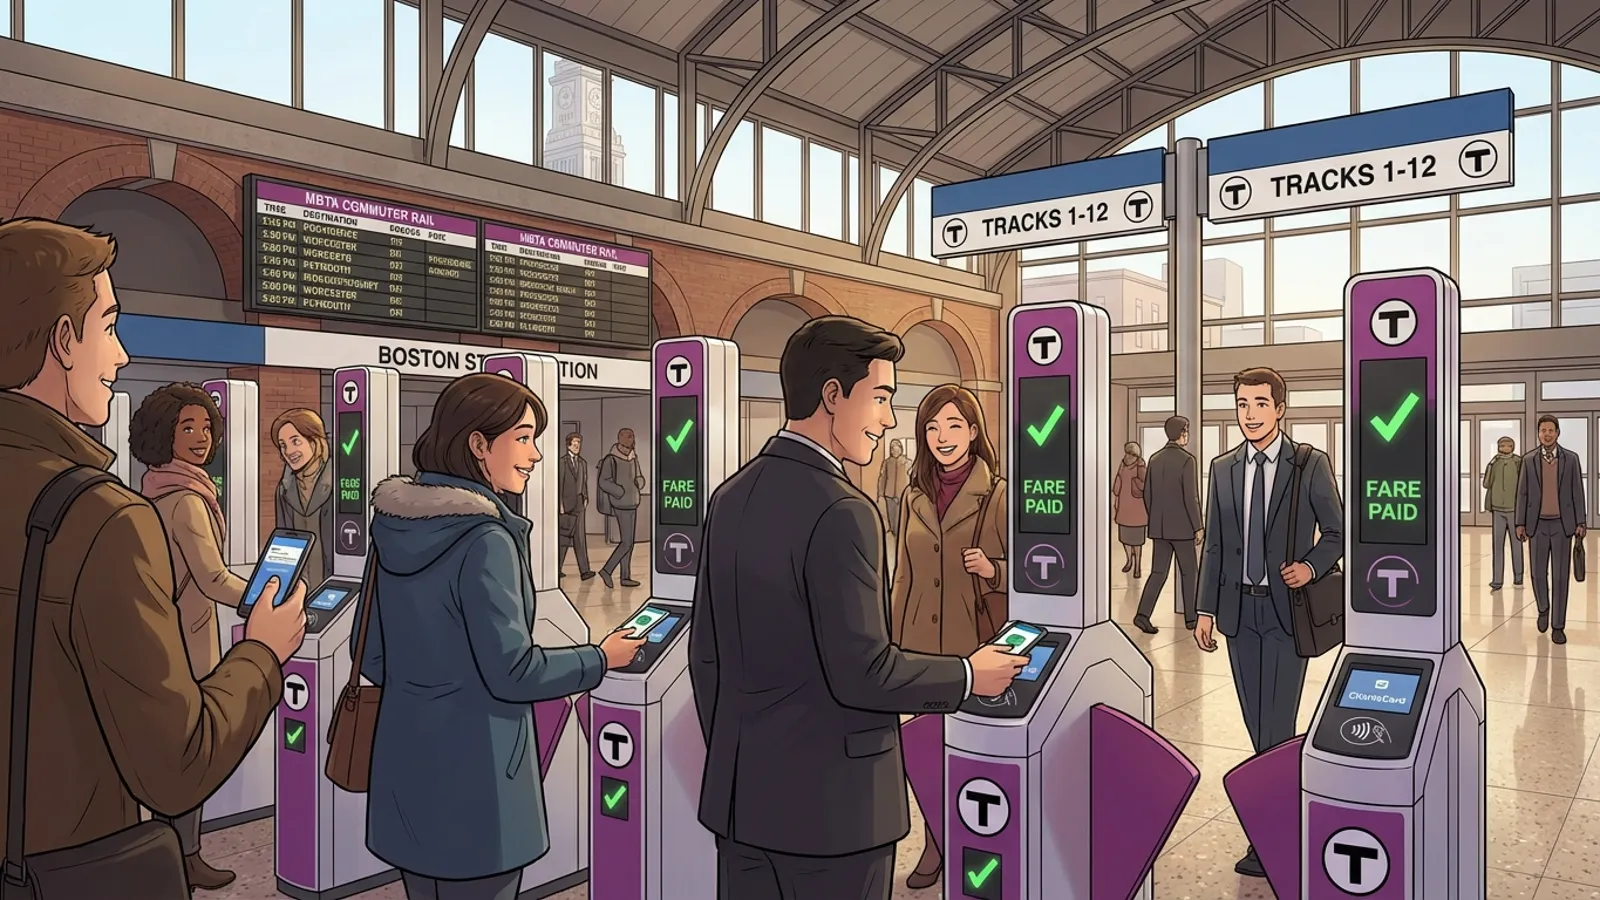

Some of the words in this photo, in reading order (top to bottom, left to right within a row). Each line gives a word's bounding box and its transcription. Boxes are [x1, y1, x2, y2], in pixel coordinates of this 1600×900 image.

[1224, 183, 1247, 205] T
[1270, 164, 1374, 197] TRACKS
[1383, 154, 1436, 182] 1-12
[1464, 149, 1491, 172] T
[946, 225, 963, 243] T
[982, 208, 1061, 237] TRACKS
[1068, 202, 1108, 226] 1-12
[1128, 198, 1148, 218] T
[1378, 310, 1410, 338] T
[379, 345, 459, 370] BOSTON
[1032, 335, 1057, 360] T
[670, 363, 688, 383] T
[344, 386, 356, 402] T
[662, 480, 695, 493] FARE
[1023, 479, 1066, 495] FARE
[1366, 480, 1421, 499] FARE
[664, 496, 693, 509] PAID
[1025, 499, 1064, 514] PAID
[1368, 503, 1419, 521] PAID
[344, 528, 357, 545] T
[669, 542, 688, 563] T
[1032, 555, 1057, 580] T
[1377, 568, 1409, 598] T
[286, 681, 305, 705] T
[603, 732, 628, 761] T
[966, 790, 1001, 827] T
[1333, 842, 1379, 885] T
